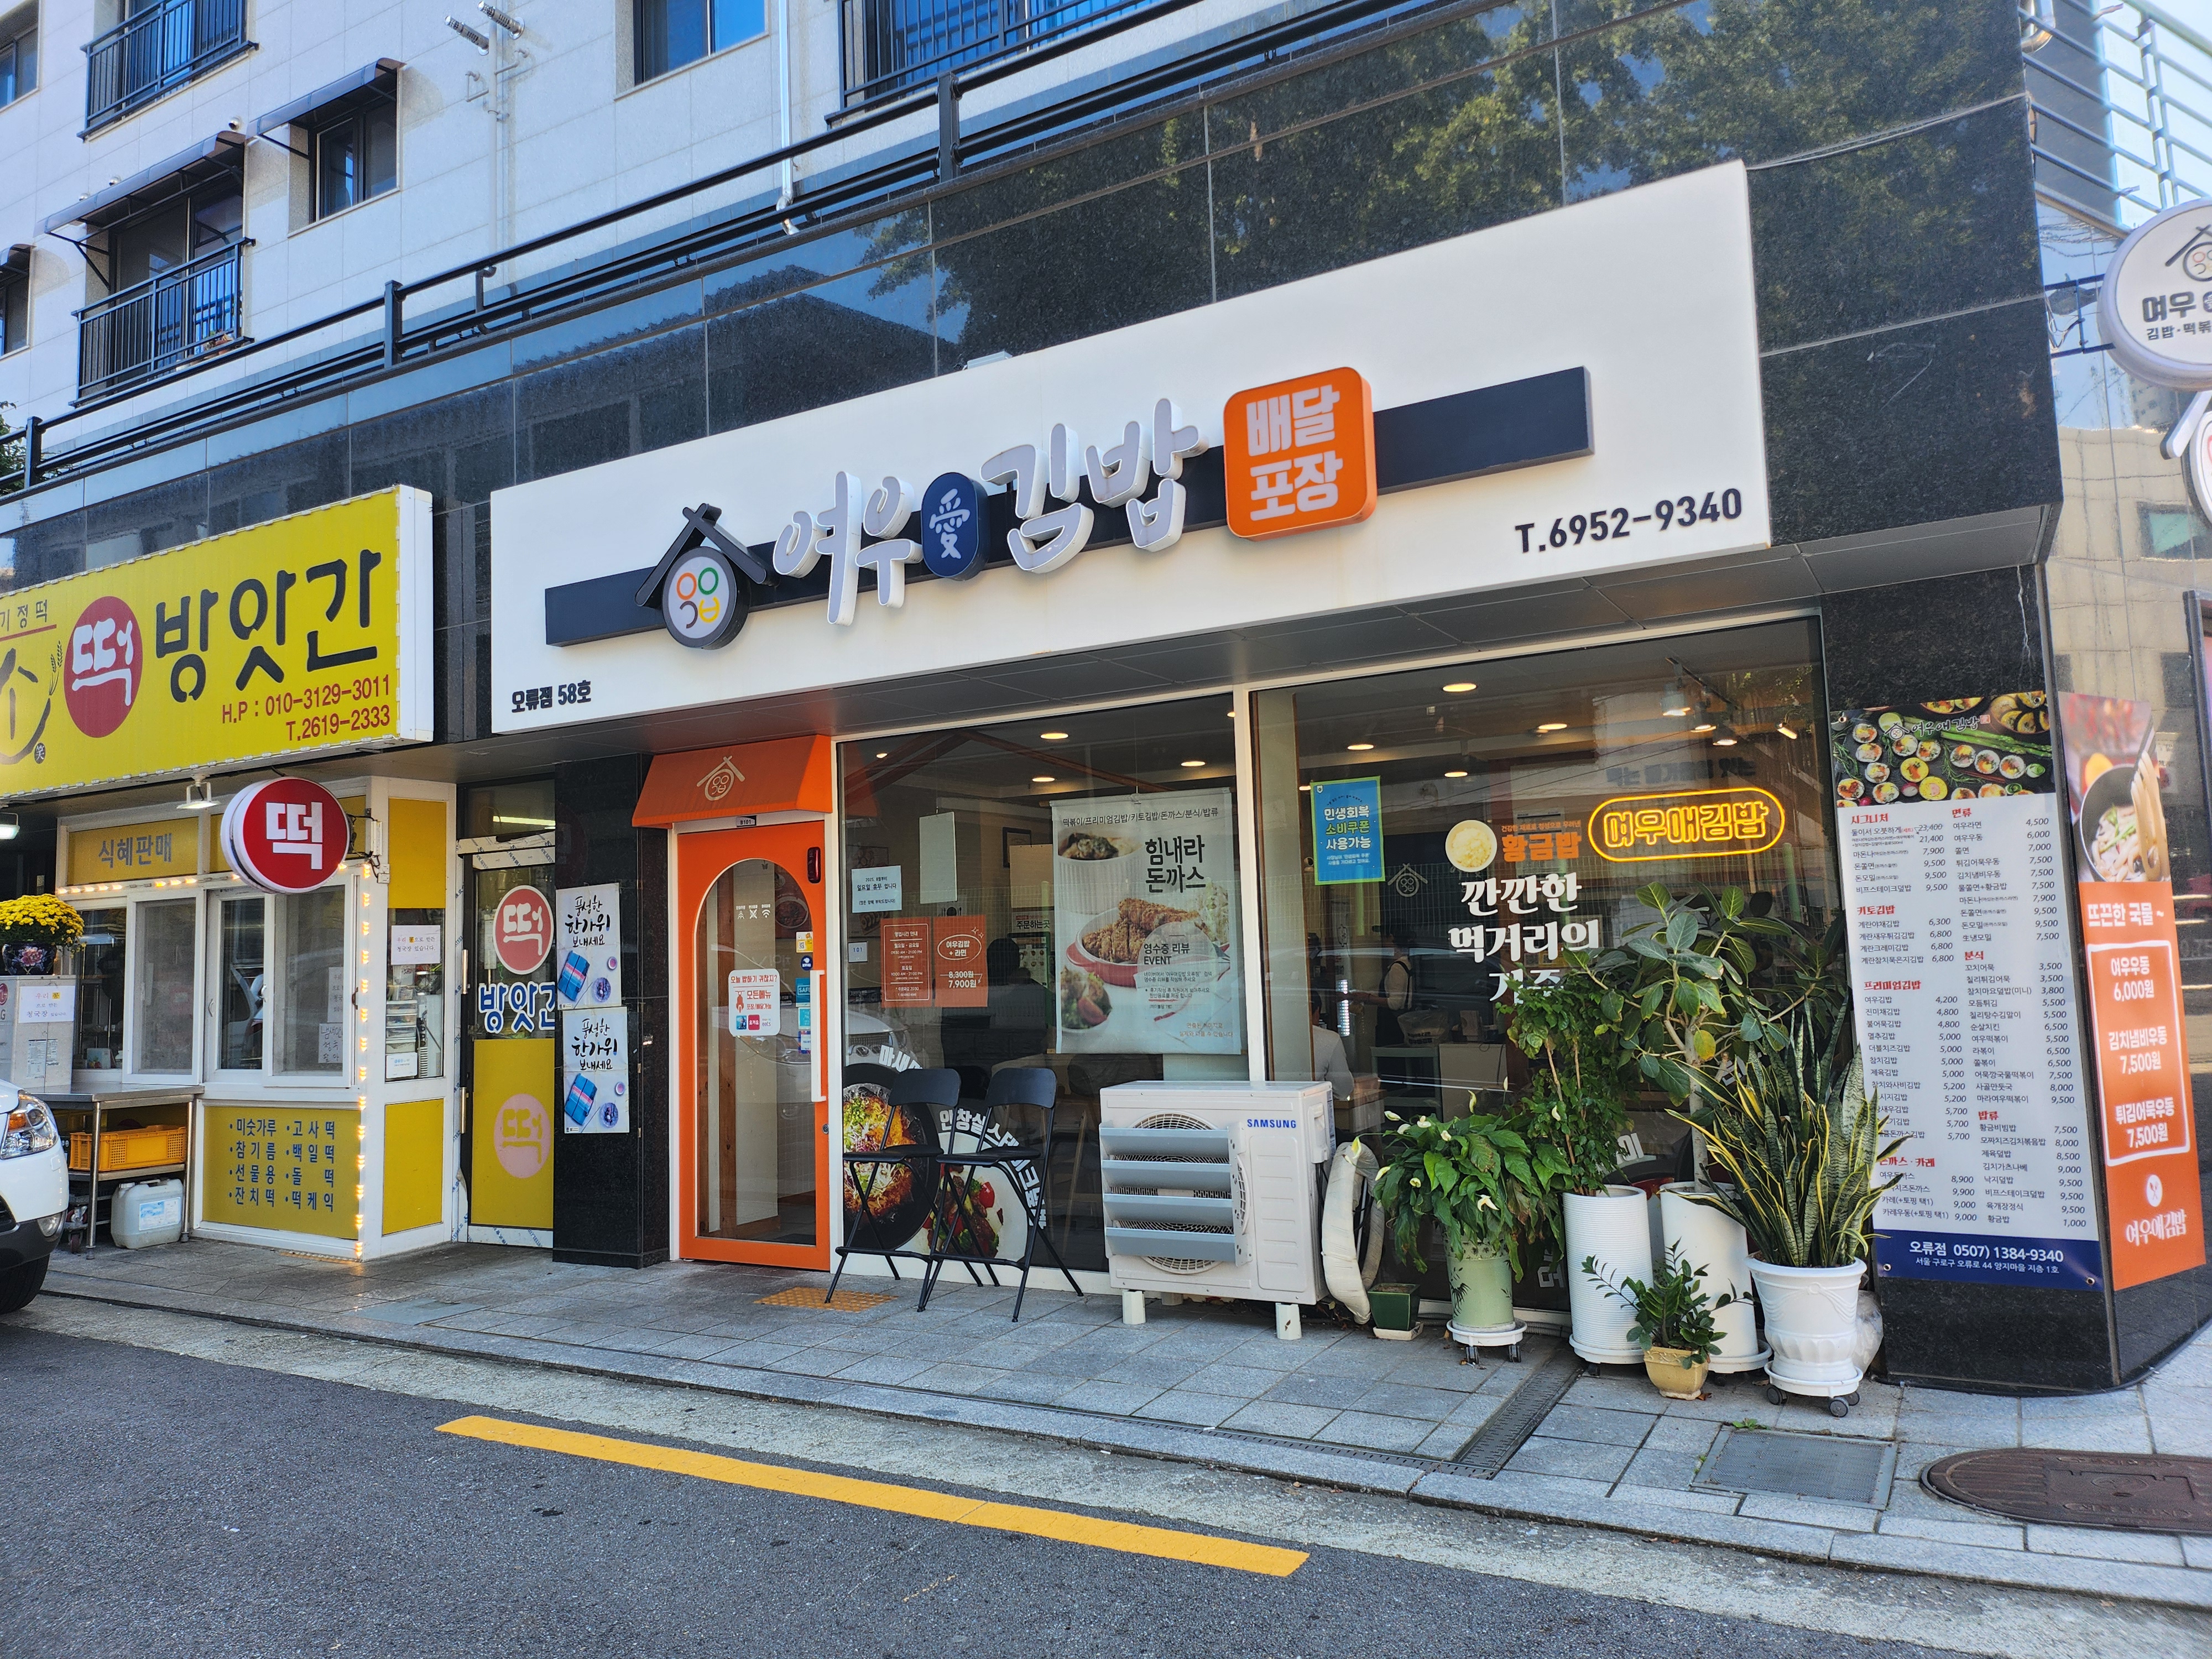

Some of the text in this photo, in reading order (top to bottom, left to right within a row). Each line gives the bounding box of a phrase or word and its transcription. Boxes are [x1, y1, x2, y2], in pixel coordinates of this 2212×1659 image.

[2142, 291, 2197, 322] 여우
[1246, 384, 1340, 457] 배달
[1250, 451, 1343, 521] 포장
[773, 471, 923, 625] 여우
[980, 398, 1209, 574] 김밥
[1514, 488, 1742, 553] T.6952-9340
[72, 549, 382, 706] 떡 방앗간
[265, 675, 390, 717] 010-3129-3011
[512, 679, 592, 713] 오류점 58호
[286, 705, 390, 742] T.2619-2333
[1324, 805, 1370, 821] 민생회복
[1952, 808, 1972, 818] 면류
[1326, 820, 1370, 835] 소비쿠폰
[1603, 801, 1769, 848] 여우애김밥
[1953, 821, 1981, 830] 여우라면
[267, 802, 323, 870] 떡
[1919, 835, 1943, 843] 21,400
[1954, 833, 1983, 842] 여우우동
[1326, 836, 1371, 850] 사용가능
[1501, 832, 1582, 863] 황금밥
[2028, 843, 2051, 852] 7,000
[98, 832, 172, 868] 식혜판매
[1145, 835, 1204, 865] 힘내라
[1955, 858, 2000, 867] 튀김어묵우동
[1146, 865, 1206, 893] 돈까스
[1957, 870, 2001, 879] 김치냄비우동
[1856, 885, 1911, 893] 비프스테이크덮밥
[2031, 881, 2054, 890] 7,500
[1461, 872, 1582, 916] 깐깐한
[575, 895, 603, 916] 풍성한
[1857, 905, 1895, 916] 키토김밥
[2088, 902, 2153, 927] 뜨끈한 국물
[565, 914, 611, 934] 한가위
[1016, 920, 1050, 929] 주문하는곳
[1858, 920, 1900, 928] 계란야채김밥
[2035, 920, 2058, 928] 9,500
[572, 934, 605, 948] 보내세요
[1448, 919, 1599, 963] 먹거리의
[1859, 932, 1914, 940] 계란새우튀김김밥
[1144, 943, 1190, 954] 영수증 리뷰
[1860, 944, 1909, 952] 계란크레미김밥
[1144, 956, 1172, 964] EVENT
[1861, 954, 1954, 964] 계란참치묵은지김밥 6,800
[1964, 951, 1985, 961] 분식
[2111, 956, 2150, 976] 여우우동
[948, 979, 977, 988] 7,900원
[1864, 980, 1921, 990] 프리미엄김밥
[1966, 975, 2011, 984] 칠리튀김어묵
[747, 990, 771, 999] 모든메뉴
[1967, 987, 2032, 996] 참치마요덮밥(미니)
[2114, 979, 2154, 1001] 6,000원
[1865, 996, 1892, 1004] 여우김밥
[1865, 1008, 1900, 1016] 진미채김밥
[1970, 1011, 2021, 1019] 칠리탕수김말이
[582, 1018, 610, 1039] 풍성한
[1971, 1035, 2069, 1044] 여우떡볶이 5,500
[2109, 1026, 2167, 1051] 김치냄비우동
[572, 1036, 618, 1057] 한가위
[1973, 1047, 1995, 1055] 라볶이
[580, 1058, 613, 1070] 보내세요
[1974, 1059, 1995, 1067] 쫄볶이
[2120, 1051, 2162, 1074] 7,500원
[1871, 1081, 1921, 1089] 참치와사비김밥
[1978, 1111, 1999, 1120] 밥류
[2115, 1097, 2174, 1125] 튀김어묵우동
[237, 1118, 276, 1136] 미숫가루
[1247, 1119, 1296, 1128] SAMSUNG
[2127, 1123, 2168, 1148] 7,500원
[1980, 1137, 2046, 1146] 모짜치즈김치볶음밥
[1981, 1150, 2011, 1158] 제육덮밥
[1915, 1158, 1935, 1167] 카레
[1983, 1163, 2028, 1172] 김치가츠나베
[1984, 1176, 2013, 1184] 낙지덮밥
[1985, 1189, 2045, 1198] 비프스테이크덮밥
[1987, 1215, 2010, 1223] 황금밥
[2125, 1209, 2187, 1246] 여우애김밥
[1910, 1241, 2064, 1262] 오류점 0507) 1384-9340
[1916, 1257, 1931, 1266] 서울
[1932, 1258, 1955, 1267] 구로구
[1957, 1260, 1980, 1269] 오류로
[1994, 1262, 2026, 1272] 양지마을
[2027, 1264, 2044, 1273] 지층
[2046, 1265, 2059, 1274] 1호
